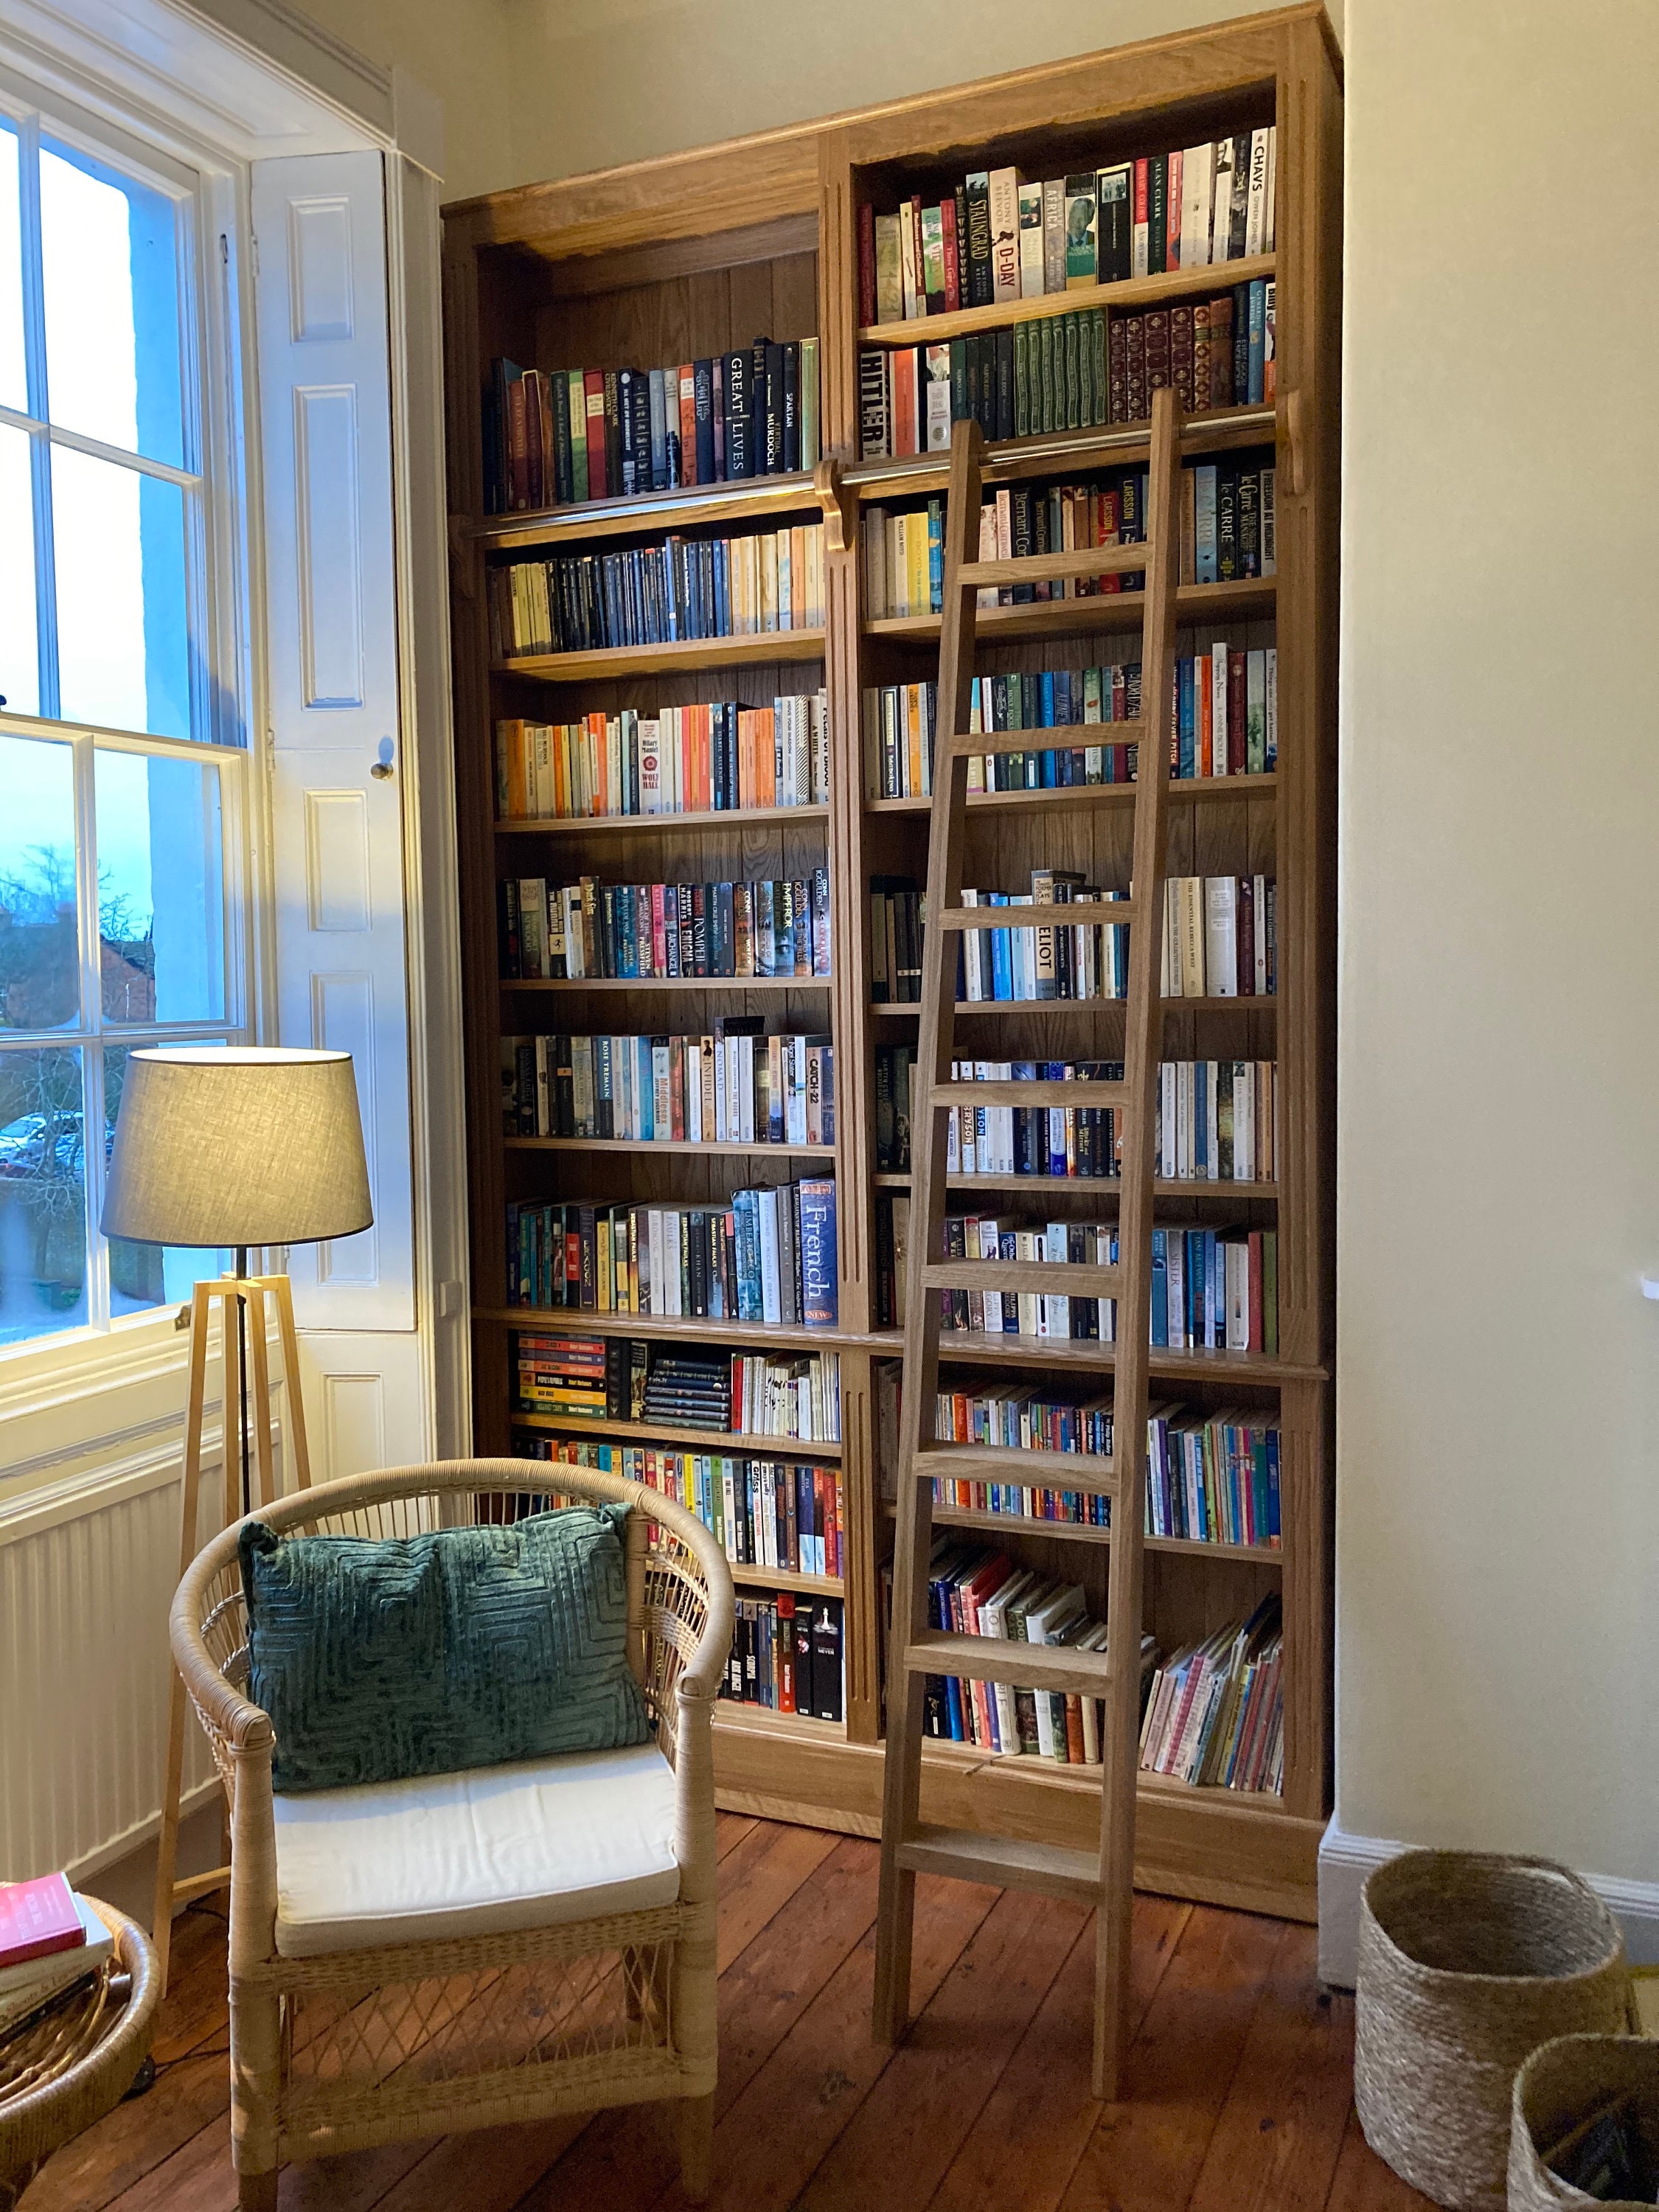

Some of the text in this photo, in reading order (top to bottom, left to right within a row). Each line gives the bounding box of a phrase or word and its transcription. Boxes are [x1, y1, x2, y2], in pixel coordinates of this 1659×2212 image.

[1253, 146, 1265, 192] CHAVS
[1047, 189, 1059, 229] AFRICA
[1154, 163, 1162, 220] ALAN CLARK
[969, 199, 989, 260] STALINGRAD
[999, 247, 1015, 286] D-DAY
[611, 373, 619, 404] KENNETH
[862, 355, 883, 442] HITLER
[731, 358, 744, 470] GREAT LIVES
[998, 494, 1009, 524] Bernard
[1014, 493, 1030, 535] Bernard
[1035, 501, 1045, 529] Bernard
[1103, 495, 1114, 530] LARSSON
[1122, 479, 1135, 520] LARSSON
[1056, 692, 1068, 717] ALONE
[782, 882, 793, 931] EMPEROR
[801, 888, 809, 911] CONN
[639, 936, 647, 977] PRESSFIELD
[667, 933, 678, 970] ARCHANGEL
[681, 930, 694, 963] ENIGMA
[693, 917, 706, 962] POMPEII
[1038, 926, 1052, 969] ELIOT
[602, 1062, 611, 1098] TREMAIN
[704, 1062, 713, 1105] INFIDEL
[716, 1050, 724, 1091] NOMAD
[810, 1058, 819, 1104] CATCH-22
[659, 1077, 668, 1124] Middlesex
[582, 1239, 593, 1288] ERAGON
[745, 1259, 755, 1279] ECO
[806, 1205, 830, 1299] French
[1170, 1252, 1180, 1287] SISTER
[809, 1310, 828, 1319] NEW
